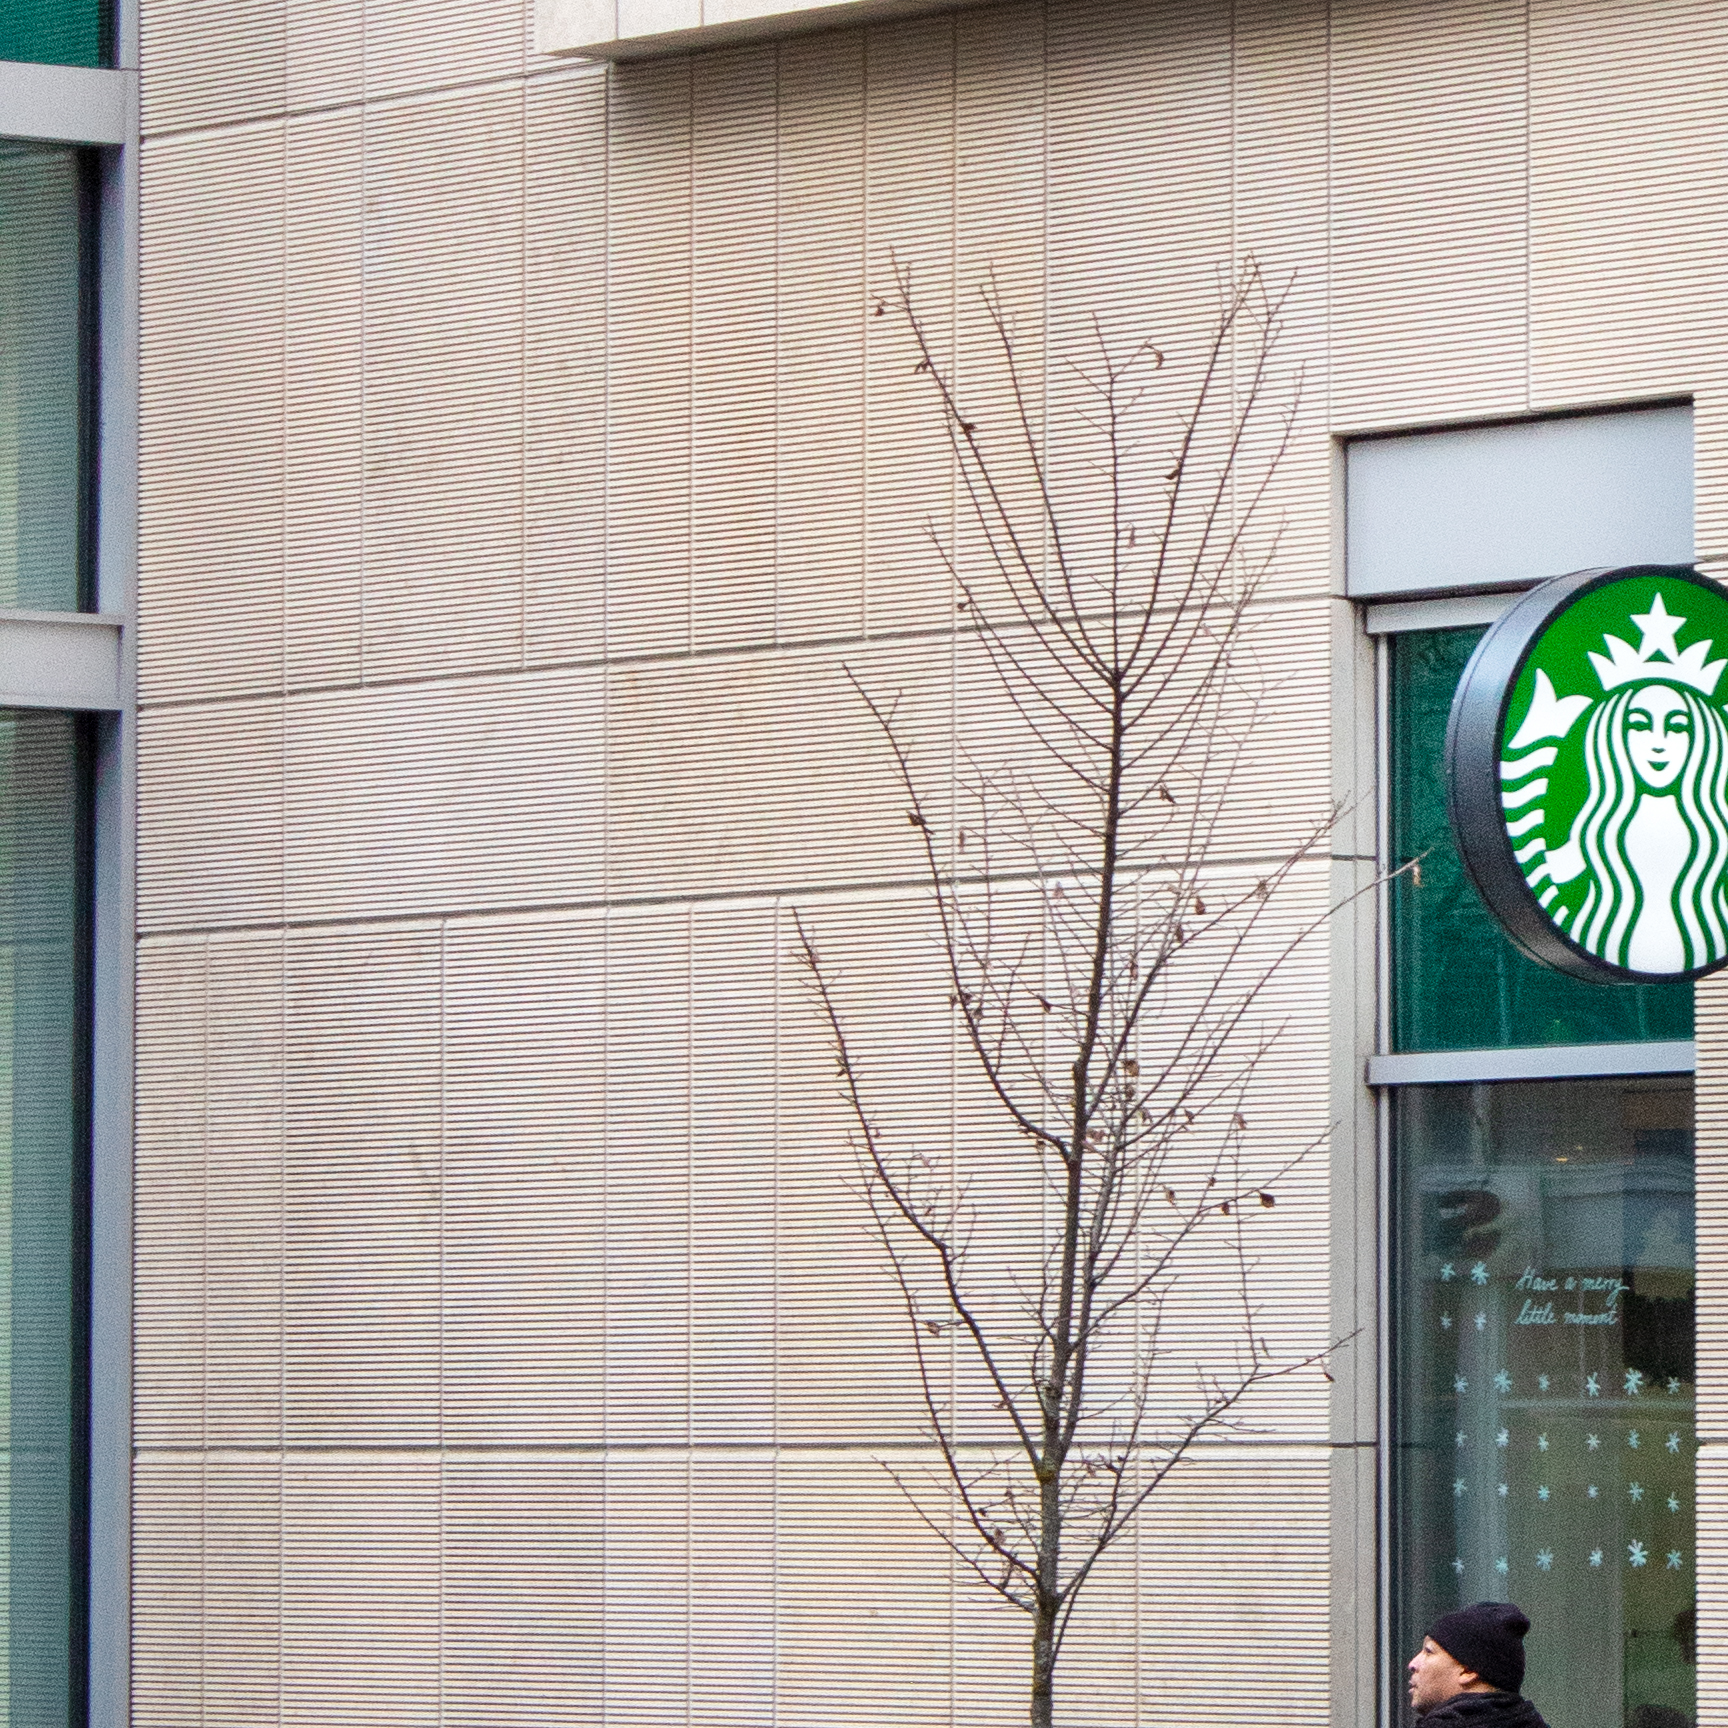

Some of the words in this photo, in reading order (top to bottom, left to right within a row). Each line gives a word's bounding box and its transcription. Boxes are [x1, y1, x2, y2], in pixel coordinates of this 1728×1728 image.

[1515, 1265, 1558, 1291] Have
[1564, 1277, 1577, 1290] a
[1514, 1299, 1556, 1325] little
[1564, 1303, 1619, 1325] moment
